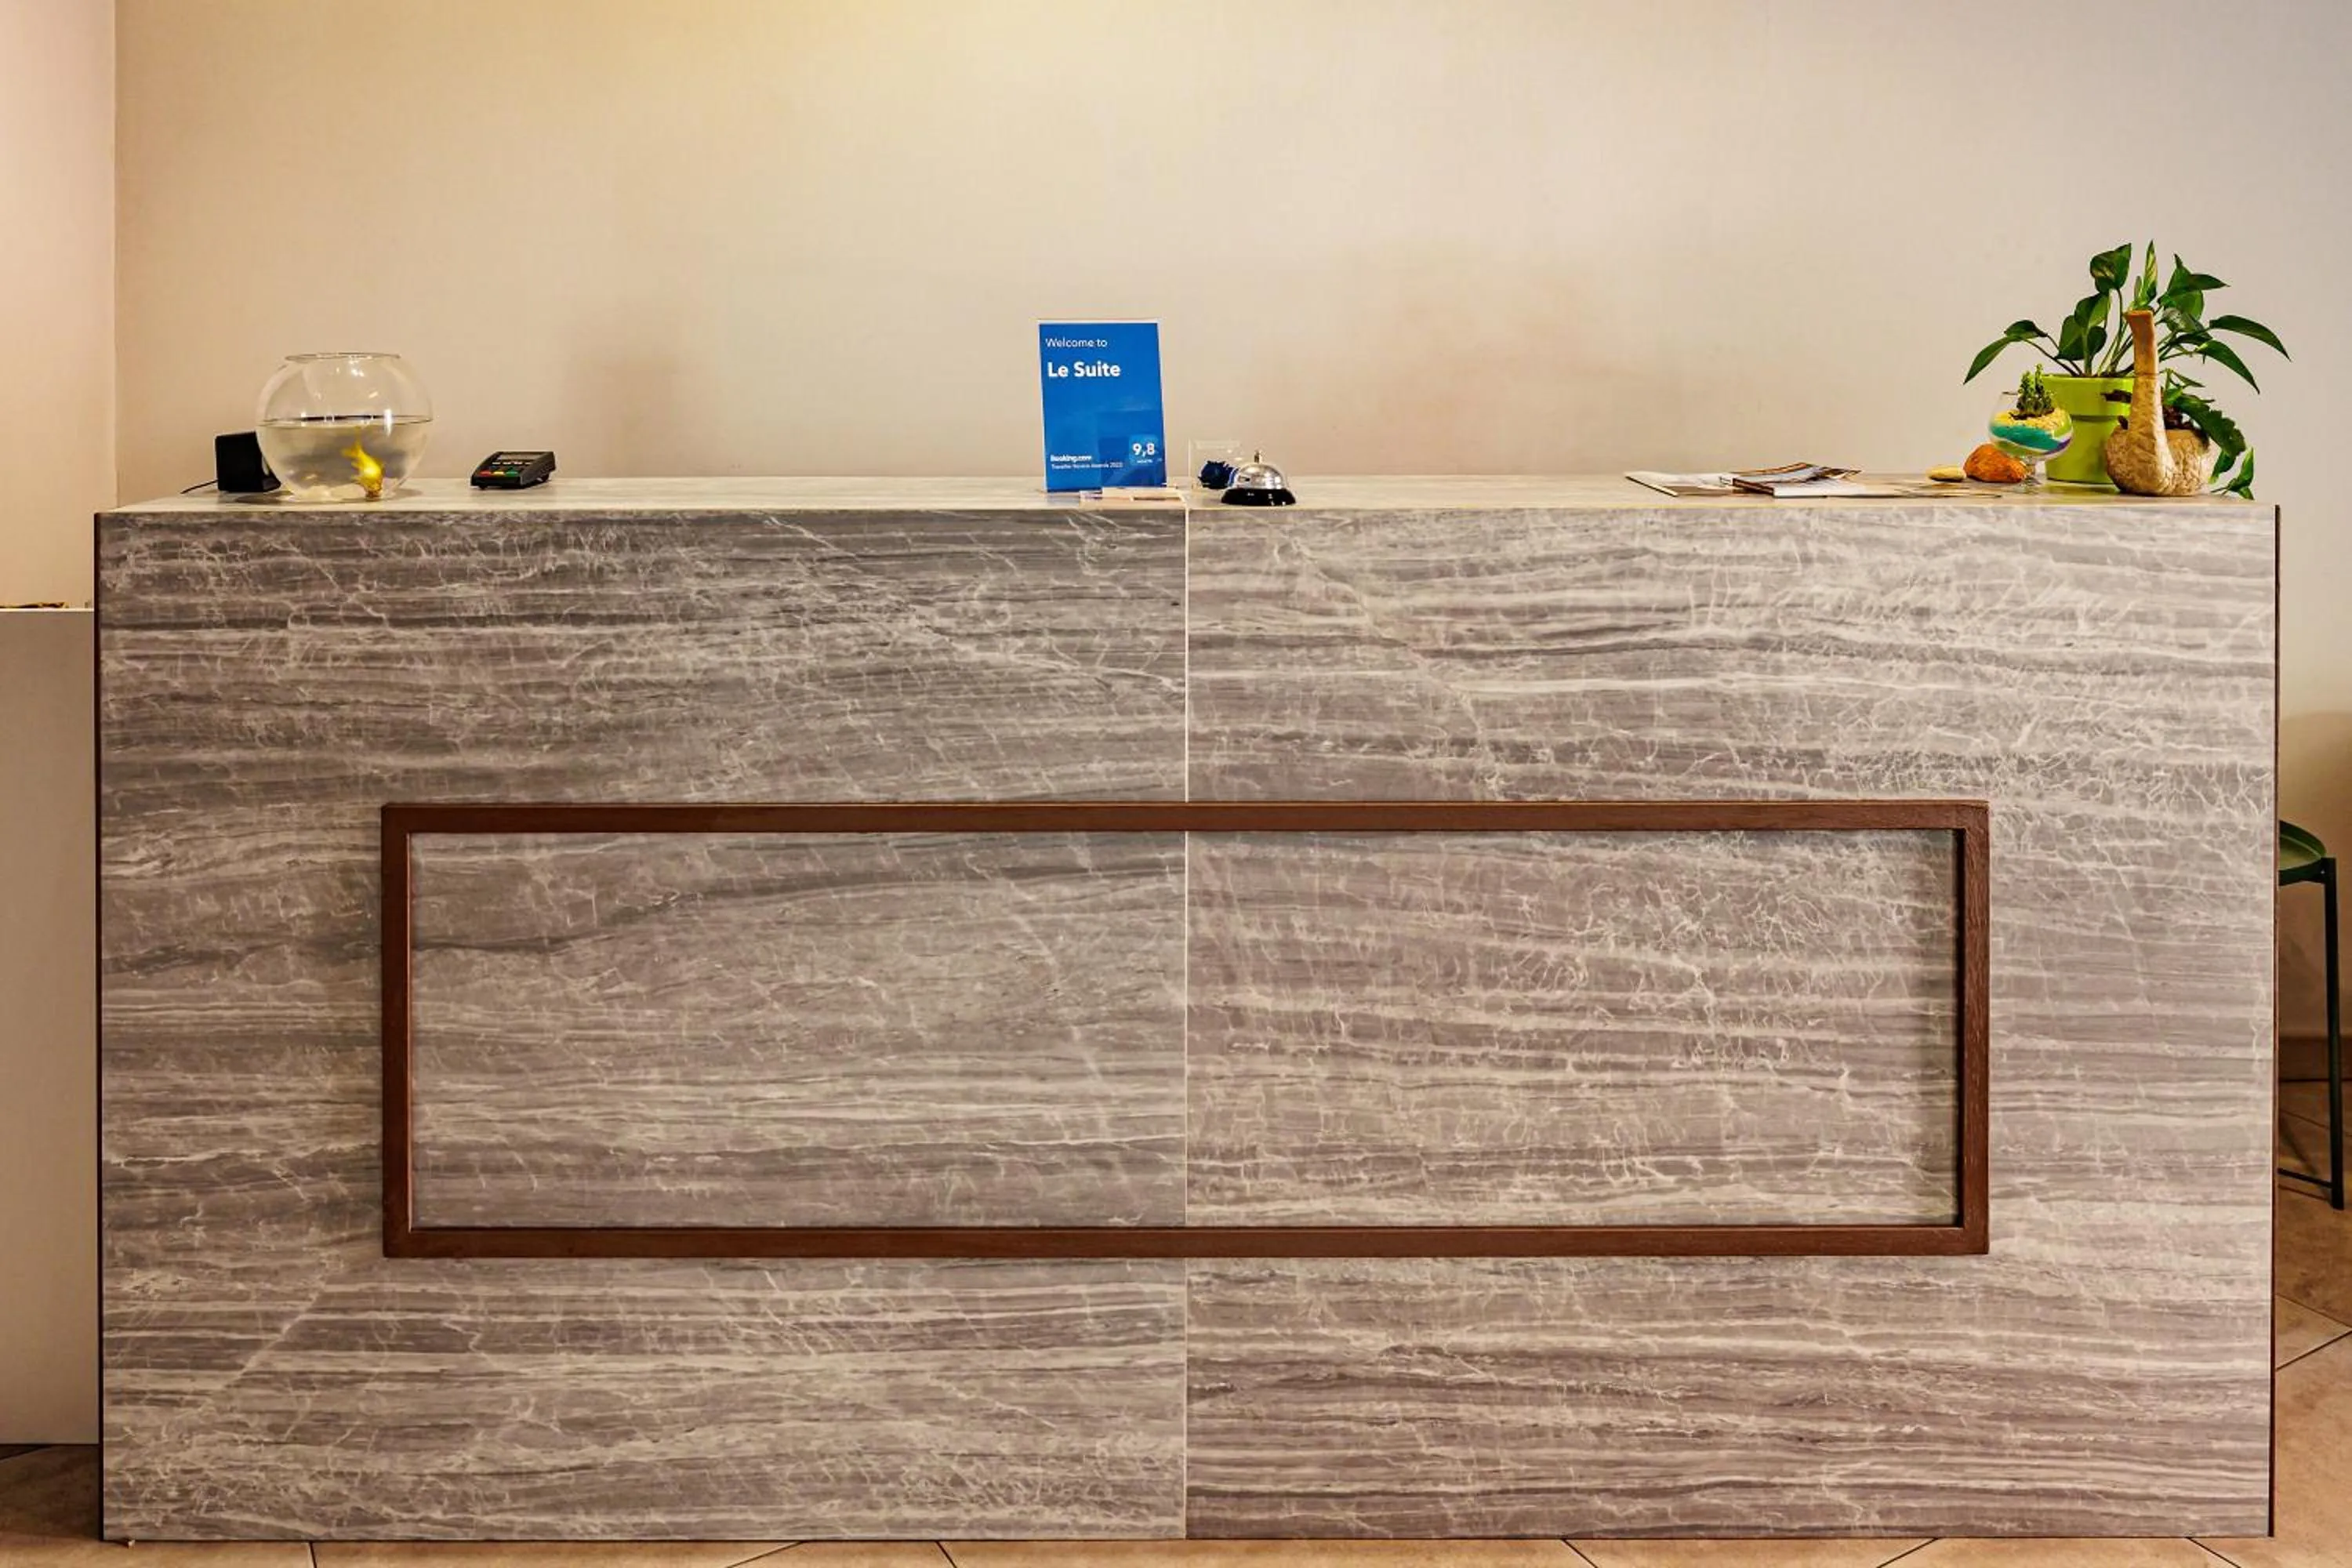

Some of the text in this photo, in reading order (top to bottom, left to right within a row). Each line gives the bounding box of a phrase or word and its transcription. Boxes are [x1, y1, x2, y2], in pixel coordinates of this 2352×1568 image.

[1045, 337, 1108, 347] Welcome to
[1047, 361, 1121, 377] Le Suite
[1132, 442, 1155, 457] 9,8
